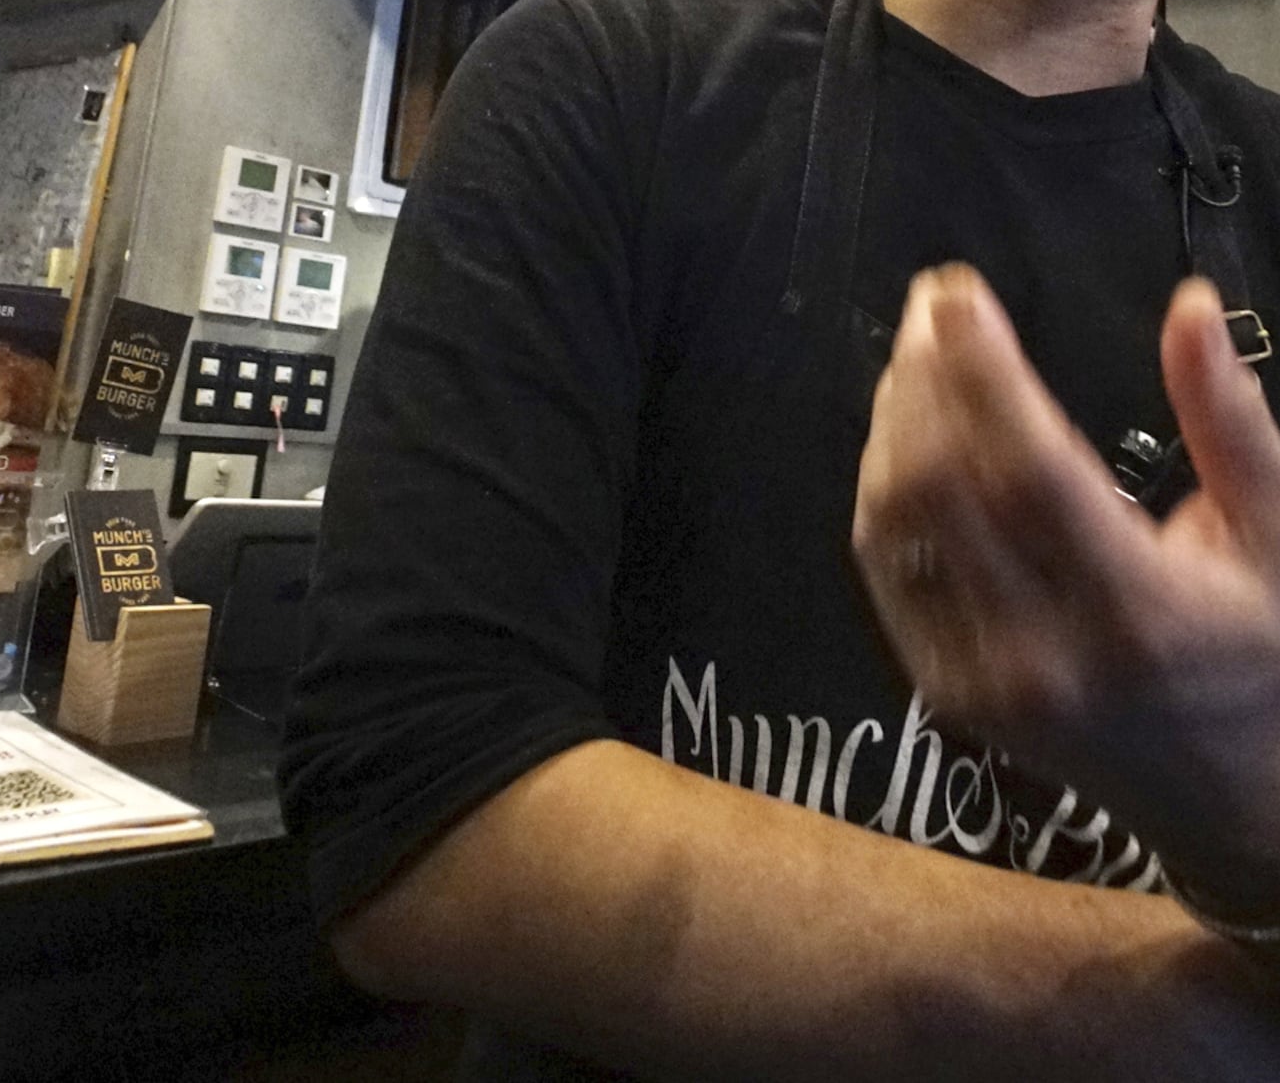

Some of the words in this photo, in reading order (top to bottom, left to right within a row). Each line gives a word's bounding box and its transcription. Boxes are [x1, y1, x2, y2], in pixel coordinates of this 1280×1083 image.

[110, 339, 170, 367] MUNCH'S
[96, 386, 156, 412] BURGER
[93, 529, 153, 545] MUNCH'S
[101, 575, 161, 593] BURGER
